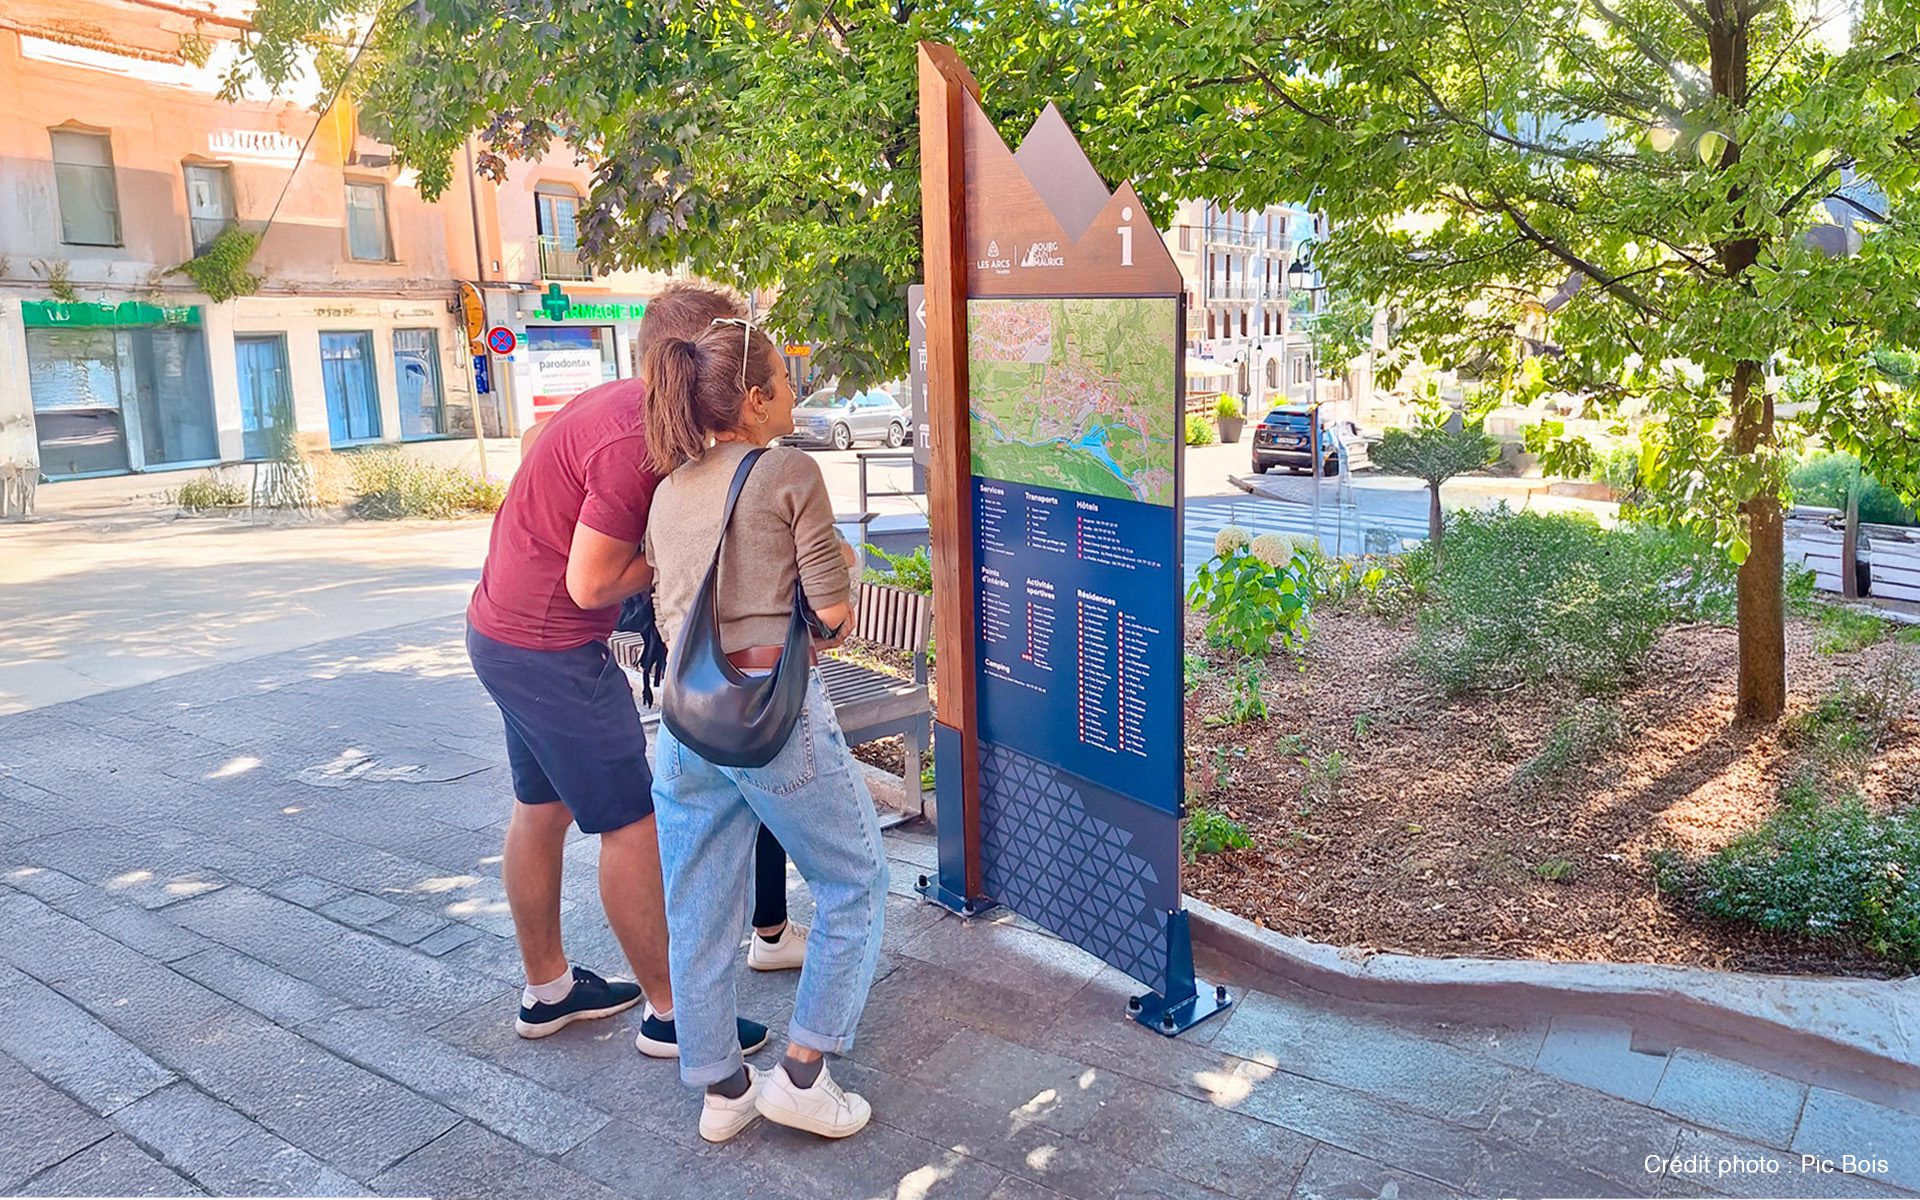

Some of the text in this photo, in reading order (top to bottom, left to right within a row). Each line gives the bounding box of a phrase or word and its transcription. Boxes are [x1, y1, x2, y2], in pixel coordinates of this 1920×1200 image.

[977, 259, 1011, 270] LES ARCS
[533, 304, 626, 320] ARMACIE
[539, 358, 591, 373] parodontax
[979, 484, 1005, 496] Services
[1024, 491, 1059, 505] Transports
[1076, 500, 1099, 512] Hôtels
[981, 566, 1000, 577] Points
[1026, 577, 1054, 591] Activités
[1026, 587, 1056, 600] sportives
[1077, 589, 1117, 606] Résidences
[984, 658, 1011, 674] Camping
